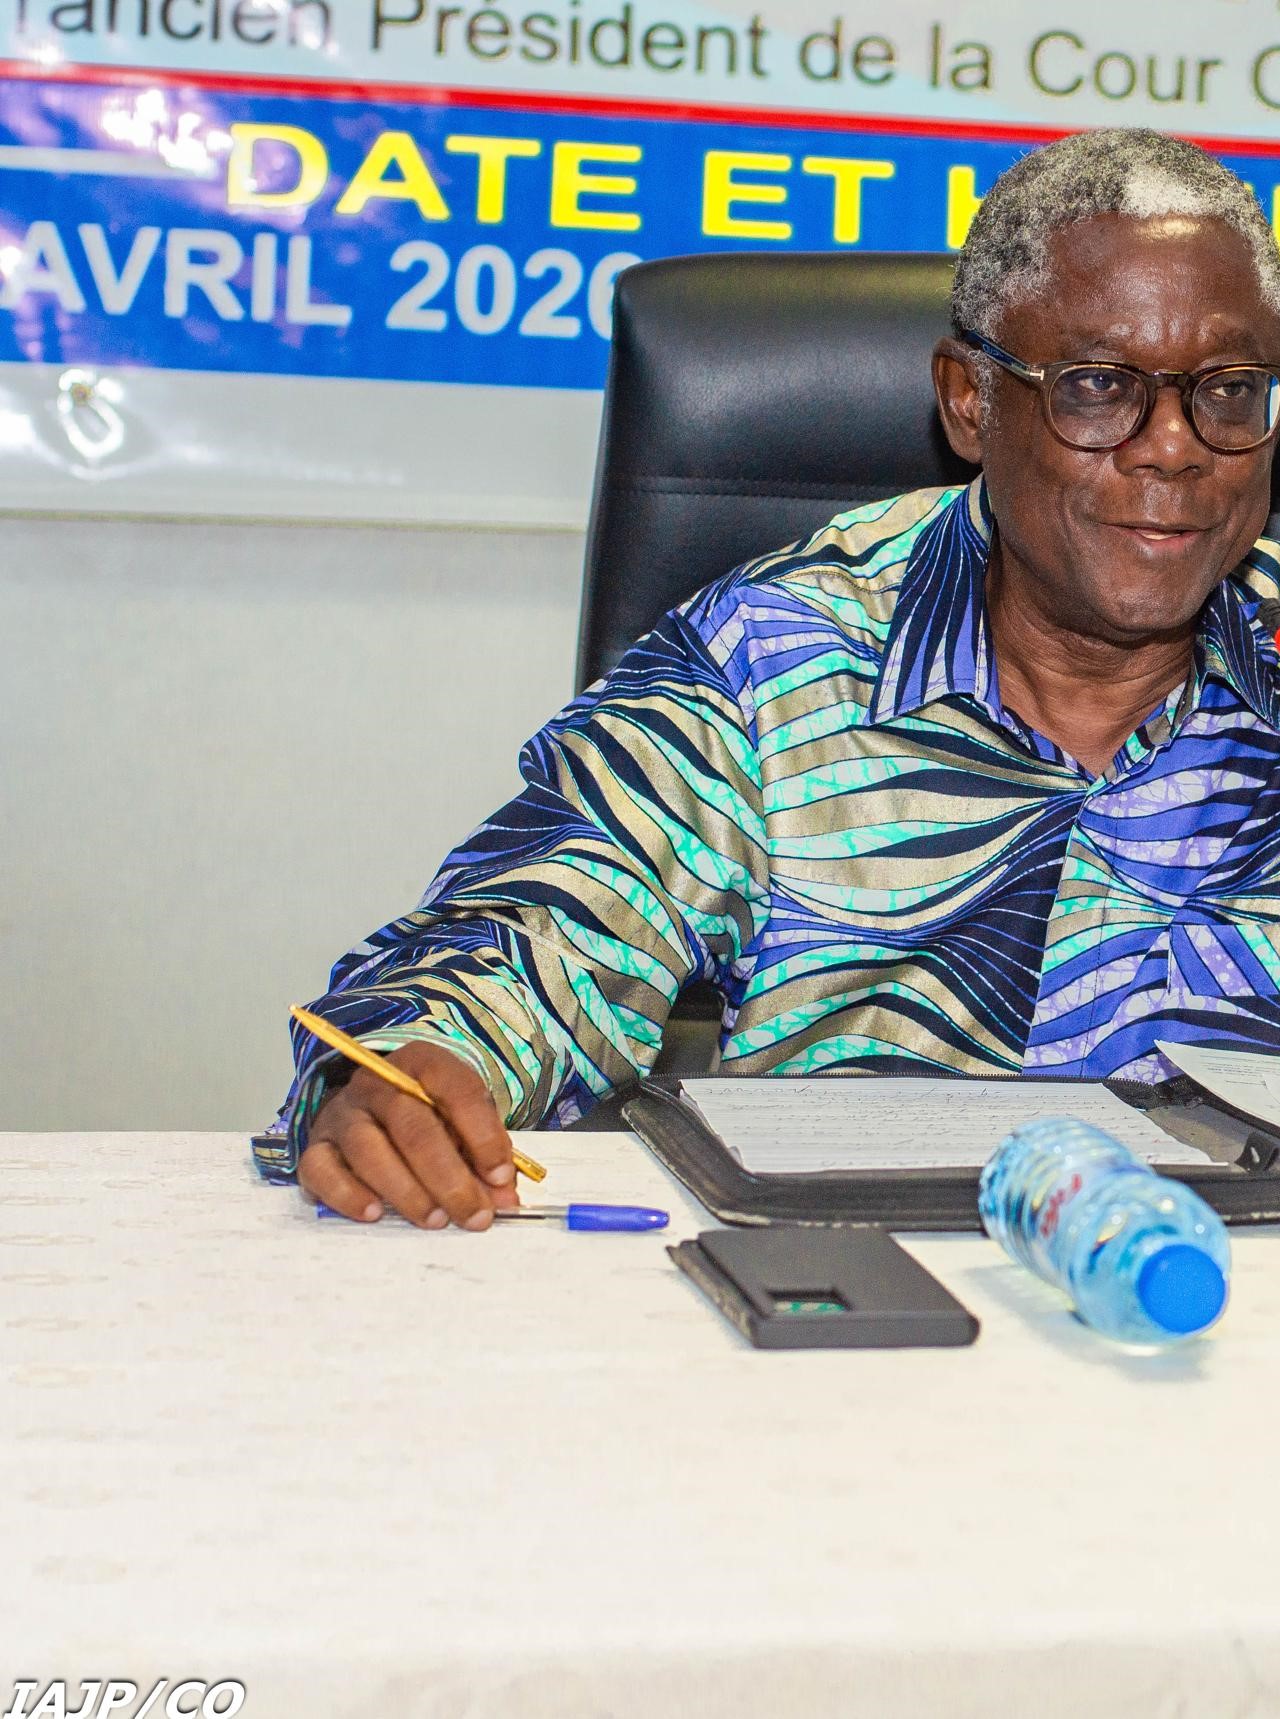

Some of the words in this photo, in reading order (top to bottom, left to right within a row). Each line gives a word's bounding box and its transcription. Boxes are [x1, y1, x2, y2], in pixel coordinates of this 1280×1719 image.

[372, 0, 769, 77] Président
[800, 18, 896, 84] de
[929, 22, 993, 91] la
[1028, 30, 1222, 102] Cour
[228, 122, 642, 231] DATE
[702, 150, 895, 244] ET
[0, 220, 352, 327] AVRIL
